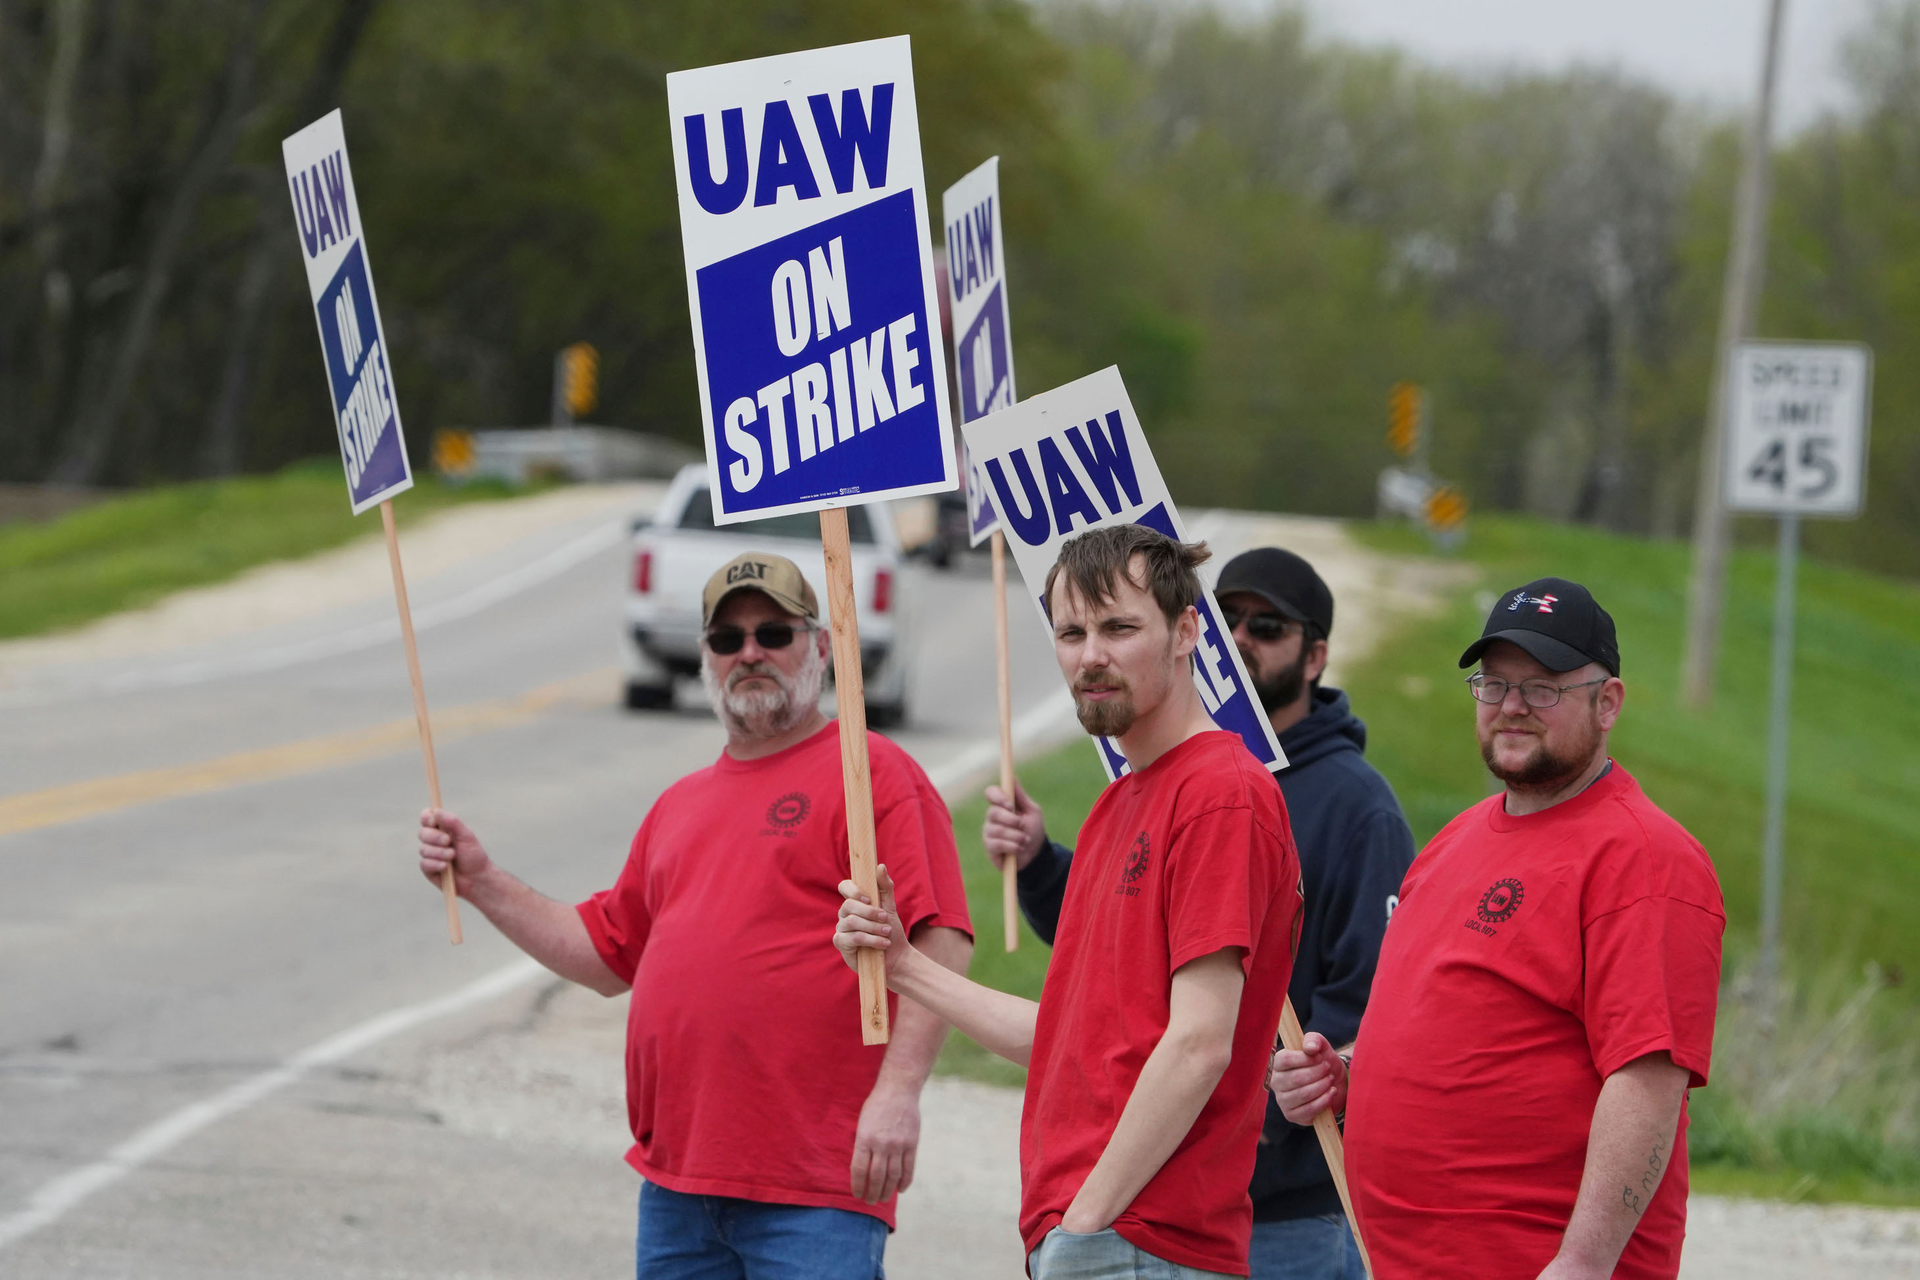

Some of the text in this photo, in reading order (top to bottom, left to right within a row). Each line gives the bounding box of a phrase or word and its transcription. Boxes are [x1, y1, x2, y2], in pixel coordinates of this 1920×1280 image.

[684, 82, 895, 215] UAW
[292, 149, 351, 259] UAW
[948, 195, 996, 303] UAW
[334, 275, 363, 377] ON
[771, 235, 851, 358] ON
[339, 338, 392, 490] STRIKE
[723, 311, 926, 494] STRIKE
[971, 315, 995, 414] ON
[1750, 360, 1843, 387] SPEED
[1755, 401, 1833, 427] LIMIT
[985, 409, 1143, 547] UAW
[1747, 436, 1839, 499] 45
[726, 561, 768, 585] CAT
[1125, 885, 1141, 897] 807
[1464, 918, 1481, 932] LOCAL
[1490, 892, 1509, 907] UAW
